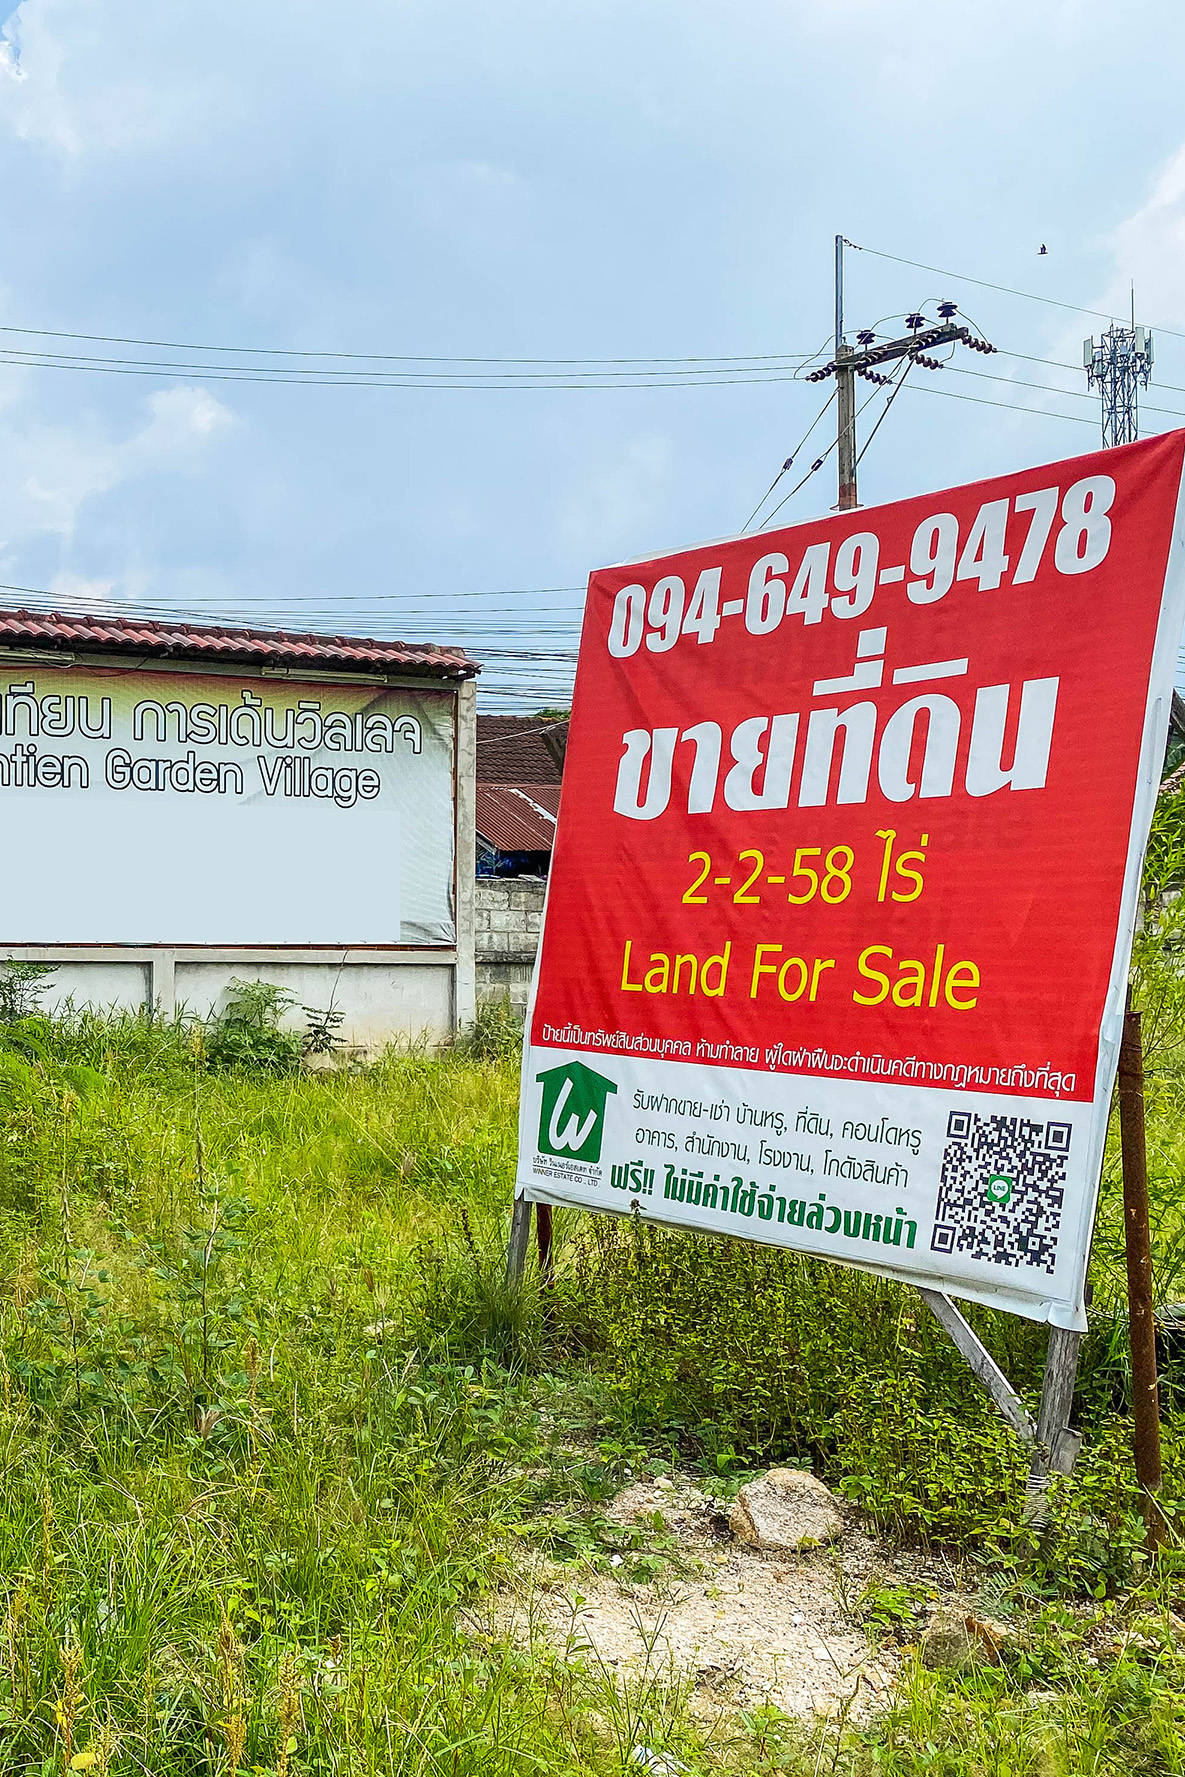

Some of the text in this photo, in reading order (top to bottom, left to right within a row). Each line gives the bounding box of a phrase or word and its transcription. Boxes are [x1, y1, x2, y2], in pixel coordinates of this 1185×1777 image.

[606, 474, 1118, 660] 094-649-9478
[133, 689, 422, 754] การเด้นวิลเลจ
[613, 626, 1060, 821] ขายที่ดิน
[105, 748, 244, 794] Garden
[256, 755, 381, 809] Village
[681, 829, 929, 904] 2-2-58 ไร่
[620, 940, 980, 1011] Land For Sale
[542, 1023, 691, 1058] ป้ายนี้เป็นทรัพย์สินส่วนบุคคล
[696, 1037, 760, 1063] ห้ามทำลาย
[632, 1088, 922, 1156] รับฝากขาย-เช่า บ้านหรู, ที่ดิน, คอนโดหรู
[532, 1167, 553, 1178] WINNER
[553, 1171, 573, 1182] ESTATE
[635, 1127, 909, 1188] อาคาร, สำนักงาน, โรงงาน, โกดังสินค้า
[609, 1160, 918, 1249] ฟรี!! ไม่มีค่าใช้จ่ายล่วงหน้า
